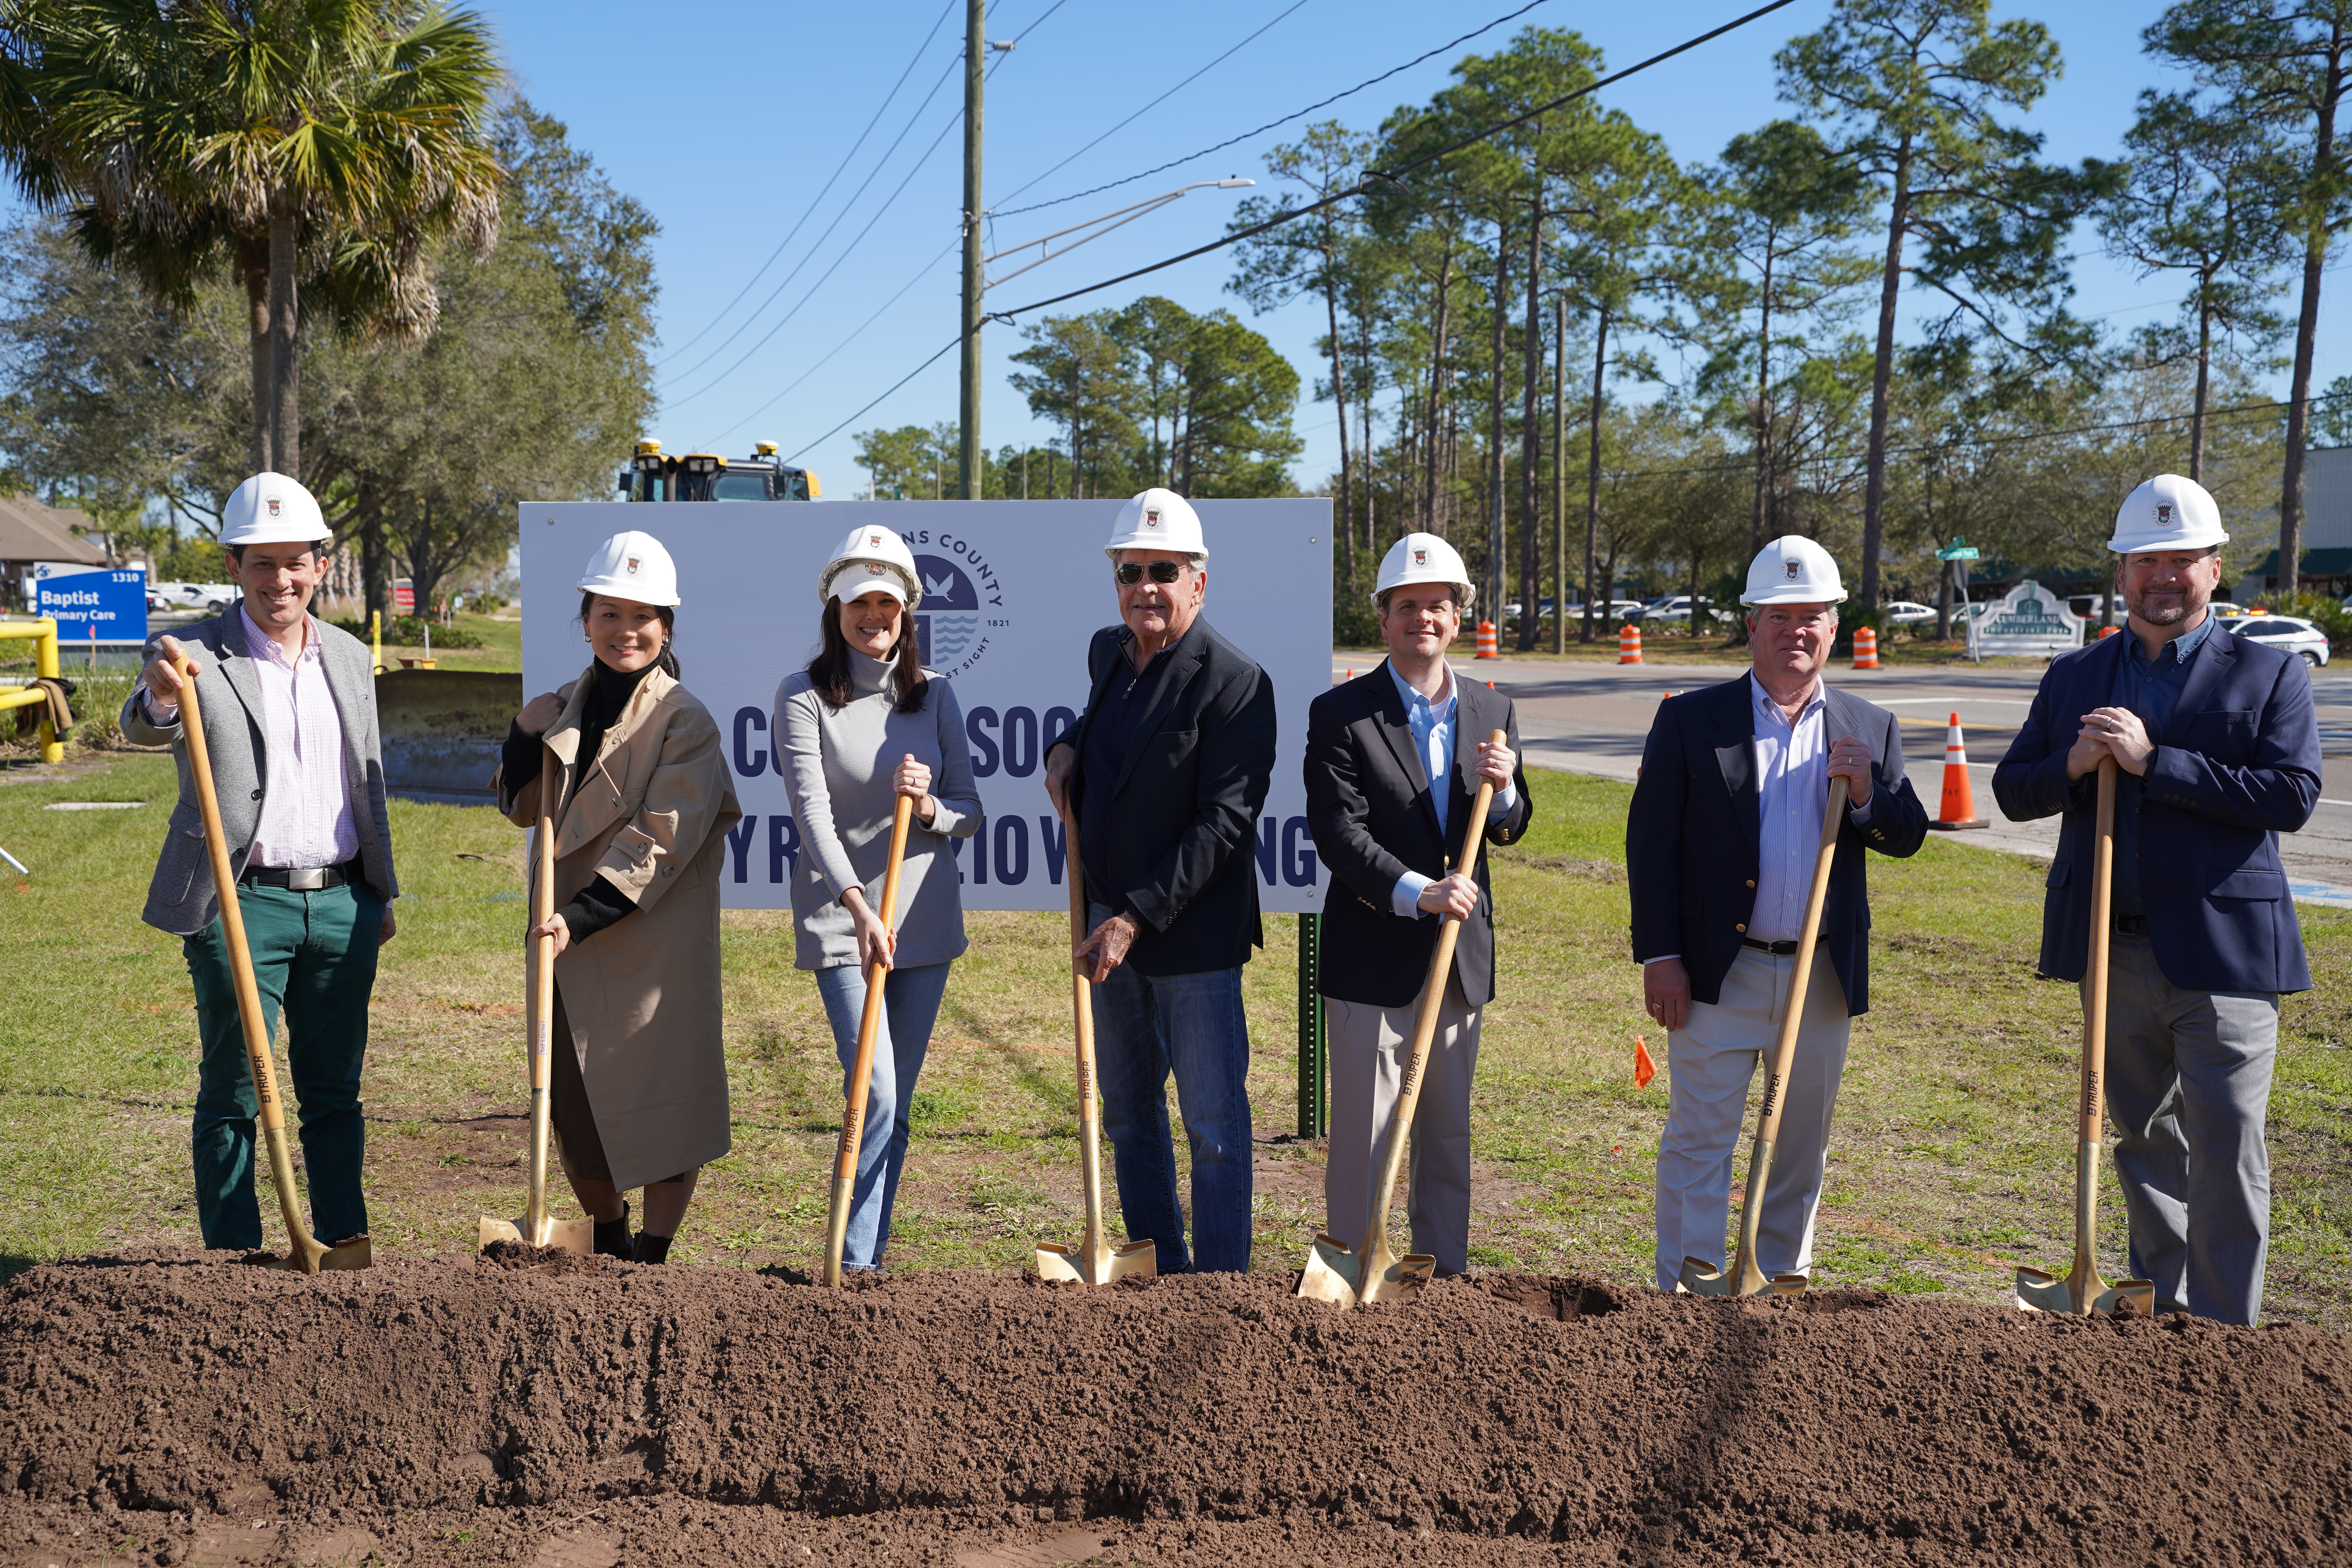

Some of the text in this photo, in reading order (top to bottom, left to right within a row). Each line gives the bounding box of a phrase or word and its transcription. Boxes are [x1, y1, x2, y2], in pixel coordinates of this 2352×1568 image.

[2154, 499, 2167, 509] JOHNS
[2167, 501, 2176, 515] COUNTY
[1784, 557, 1795, 565] JOHNS
[940, 534, 1002, 606] COUNTY
[112, 572, 139, 583] 1310
[41, 590, 100, 608] Baptist
[42, 609, 116, 622] Primary Care
[1996, 615, 2060, 624] CUMBERLAND
[963, 637, 989, 669] SIGHT
